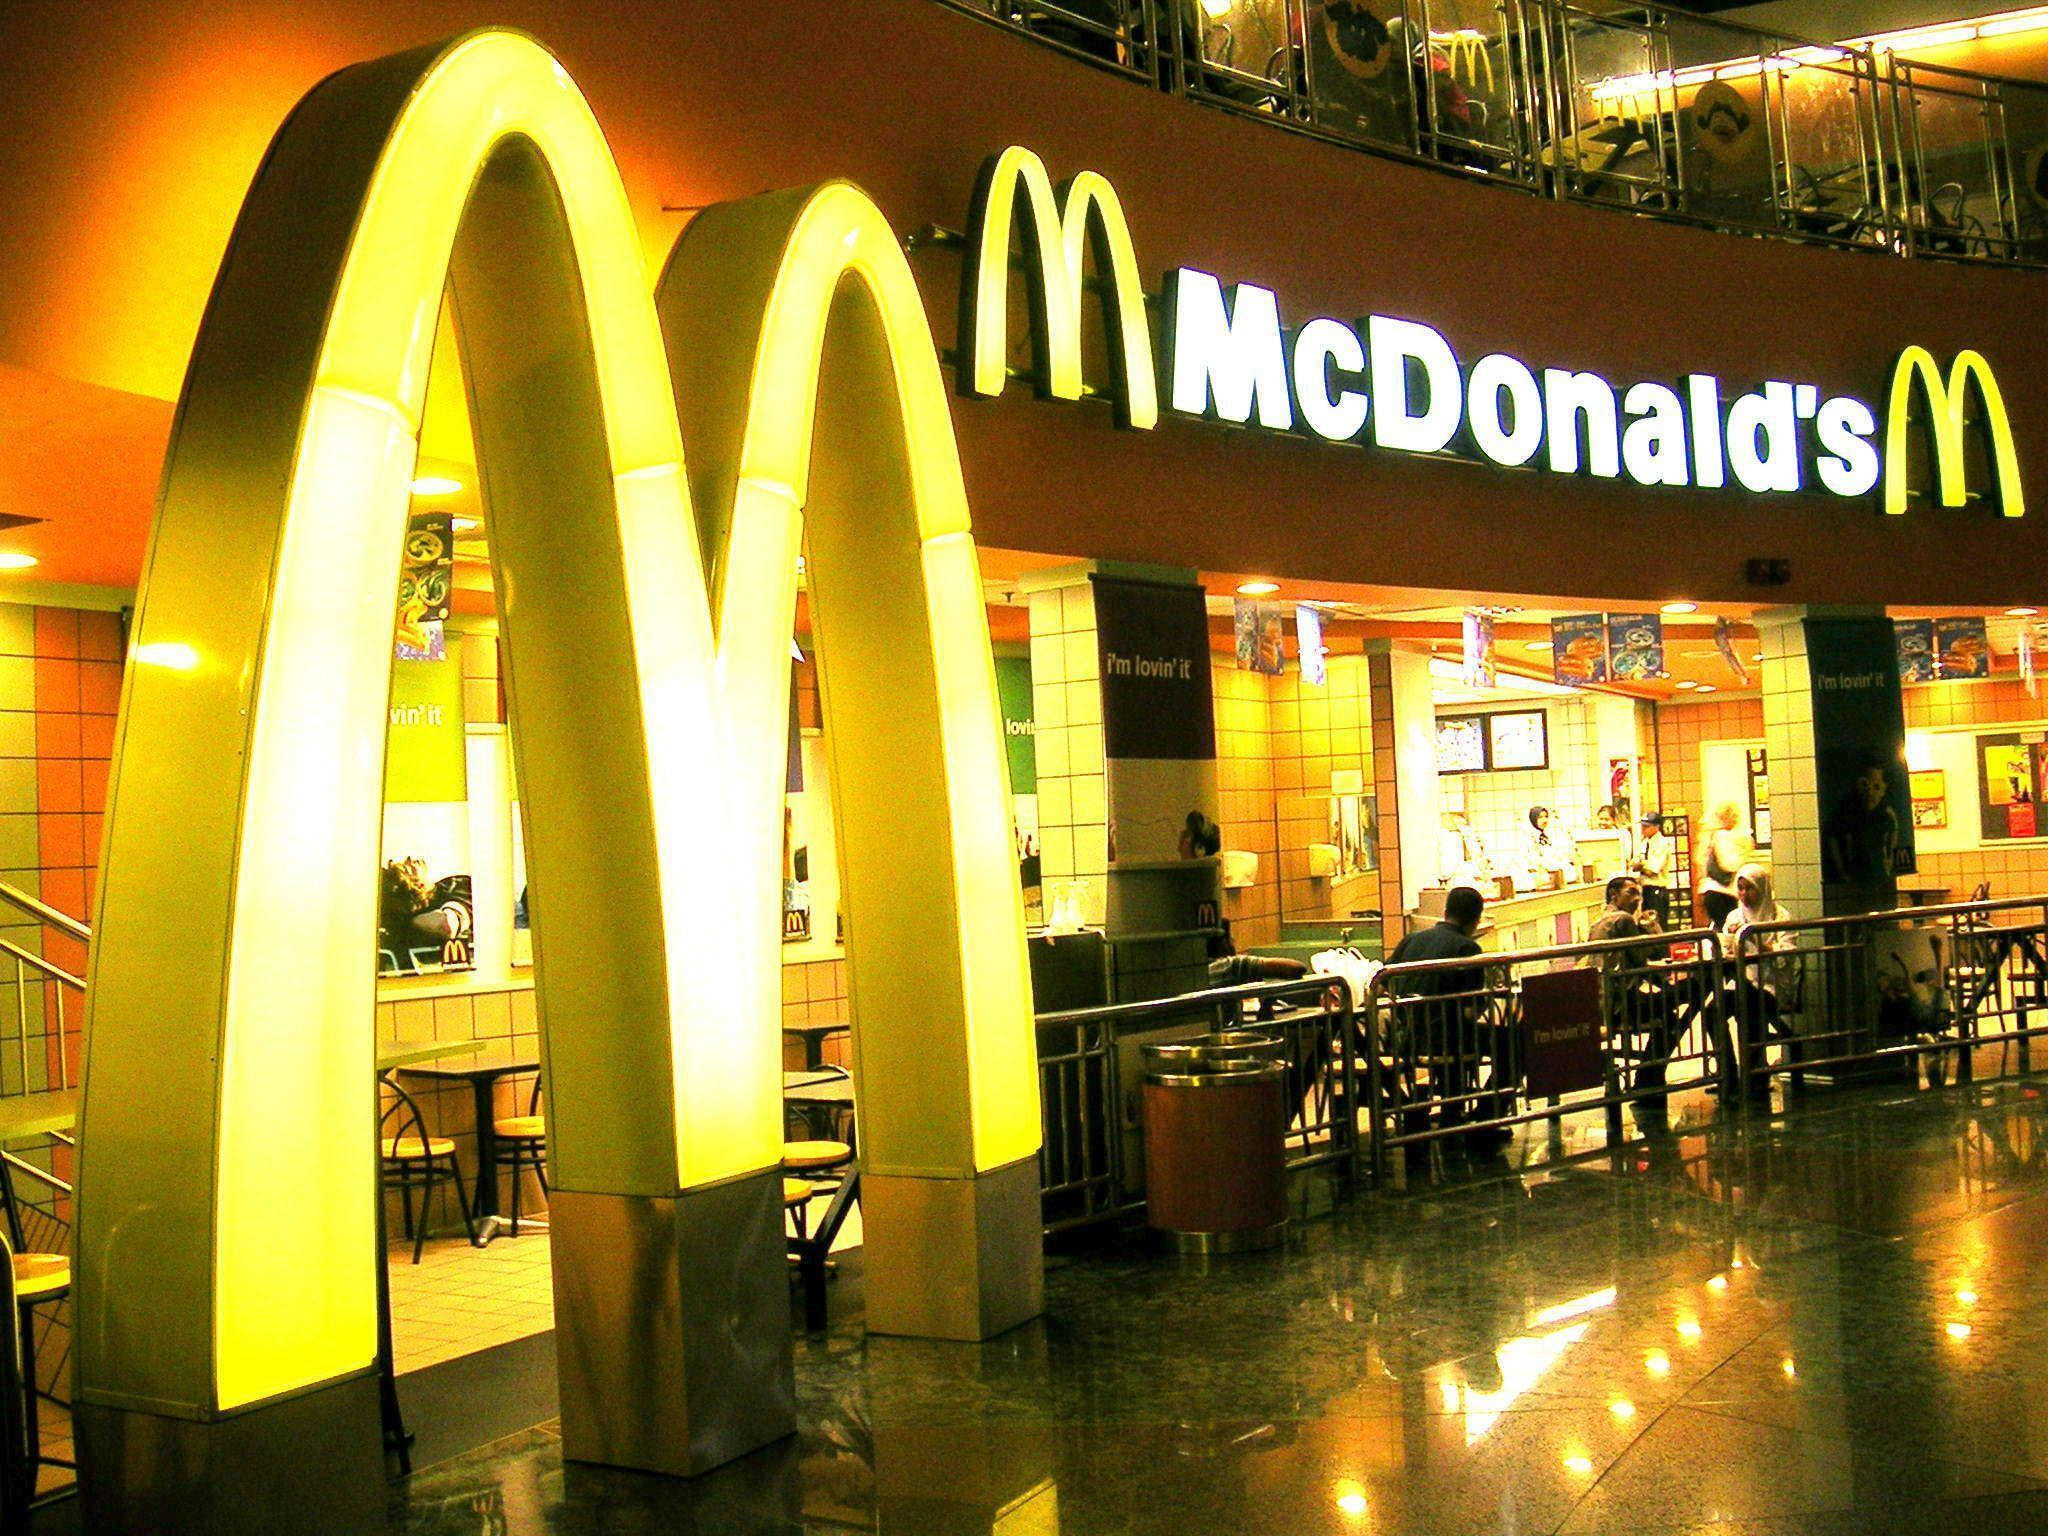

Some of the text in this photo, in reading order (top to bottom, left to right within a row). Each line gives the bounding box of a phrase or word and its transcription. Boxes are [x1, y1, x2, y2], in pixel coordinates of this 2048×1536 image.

[1173, 266, 1880, 498] McDonald's
[1107, 652, 1191, 679] i'm lovin' it
[427, 703, 443, 726] it
